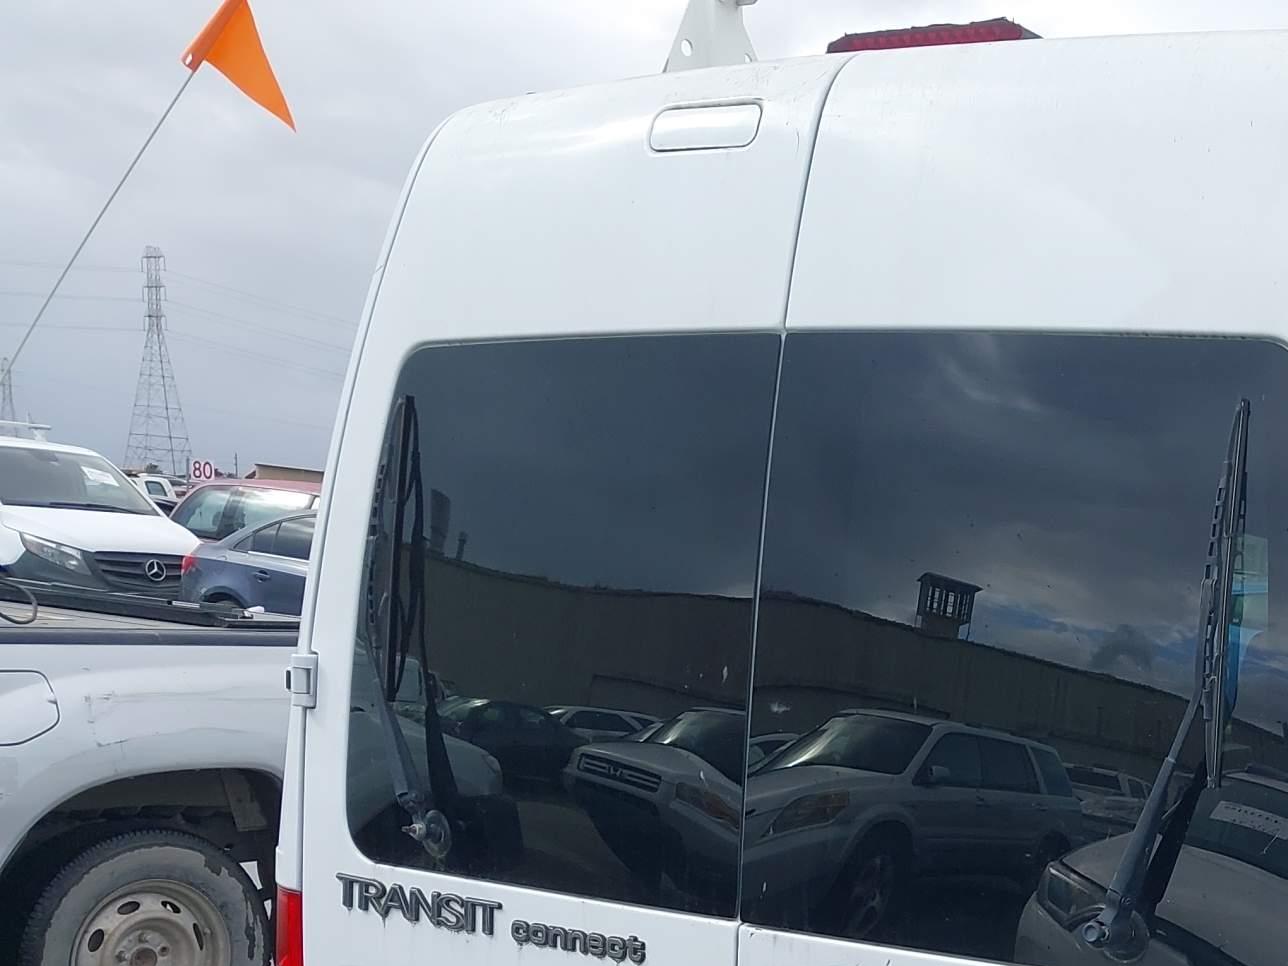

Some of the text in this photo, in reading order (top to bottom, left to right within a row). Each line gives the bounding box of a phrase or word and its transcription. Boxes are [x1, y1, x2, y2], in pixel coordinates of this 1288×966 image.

[193, 461, 213, 480] 80
[336, 872, 646, 966] TRANSIT connect
